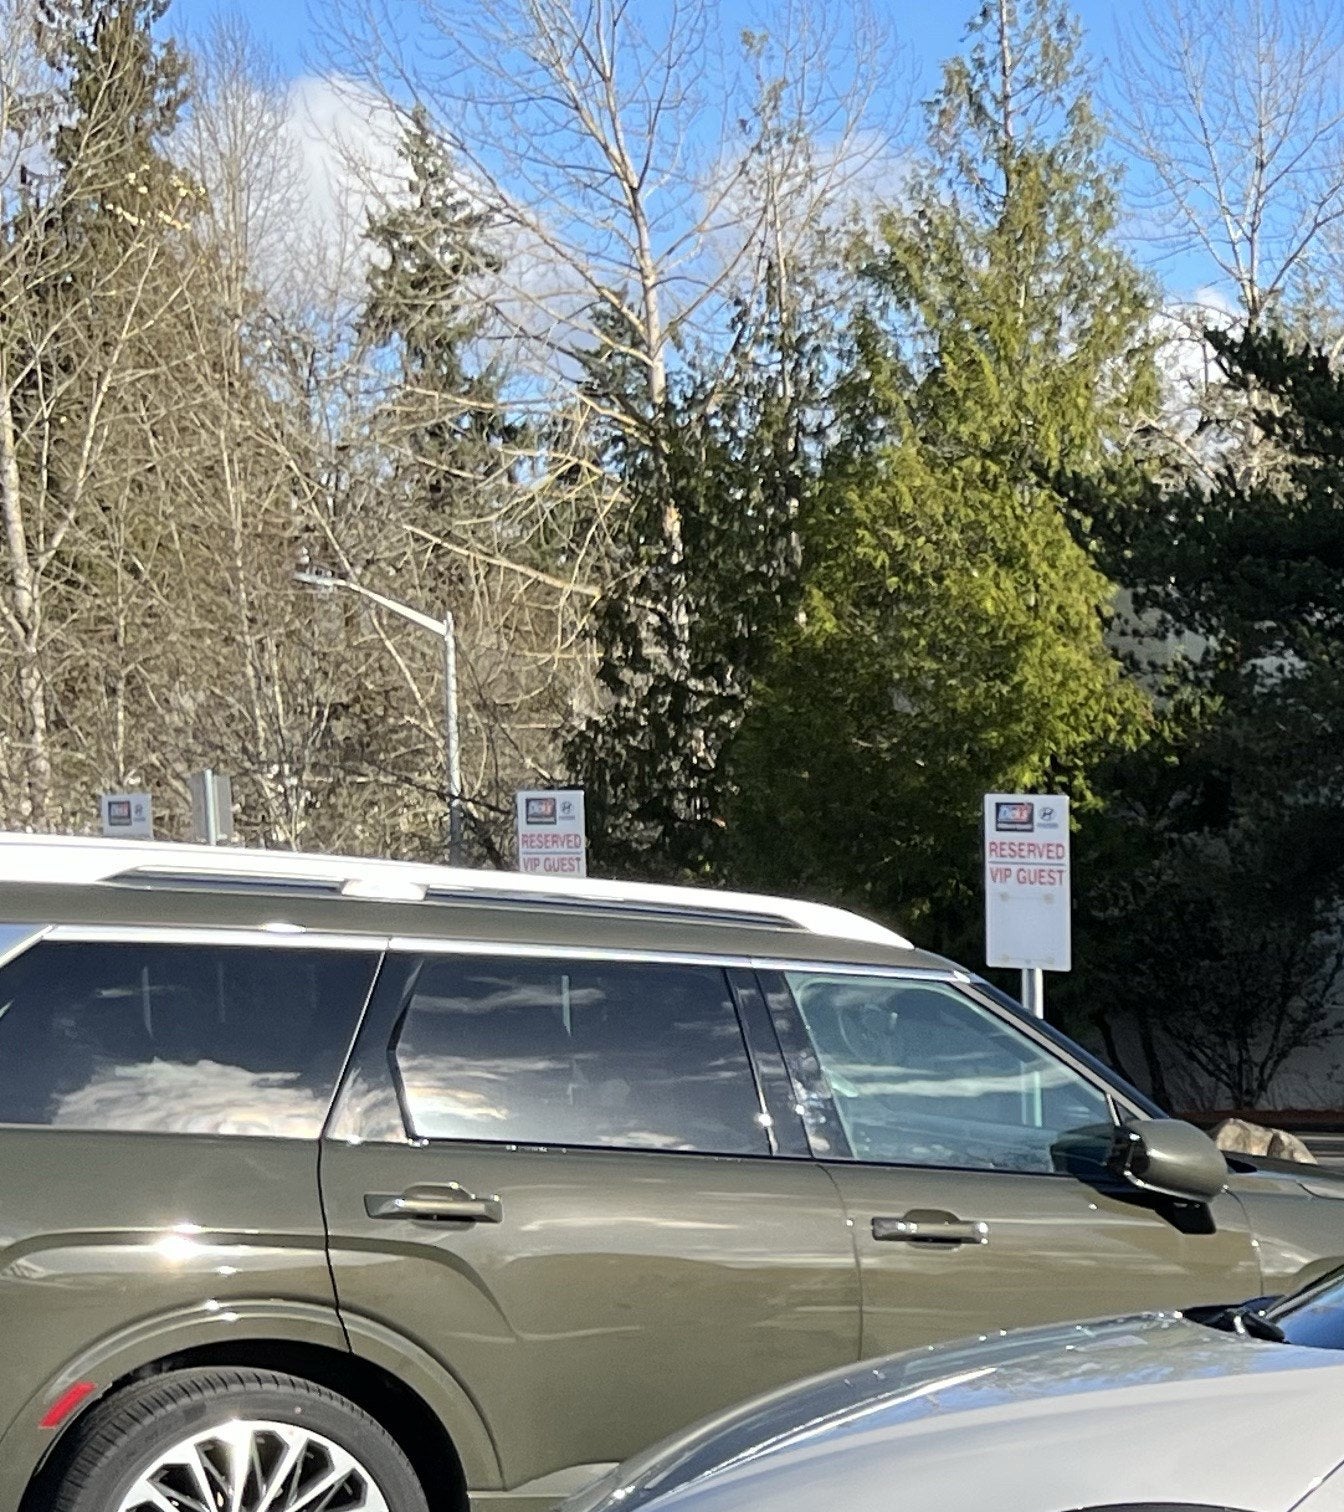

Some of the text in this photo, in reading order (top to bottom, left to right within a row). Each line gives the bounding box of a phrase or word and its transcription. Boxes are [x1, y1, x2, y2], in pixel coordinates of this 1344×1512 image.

[521, 833, 582, 850] RESERVED
[988, 841, 1066, 860] RESERVED
[522, 856, 582, 873] VIP GUEST
[988, 867, 1065, 886] VIP GUEST
